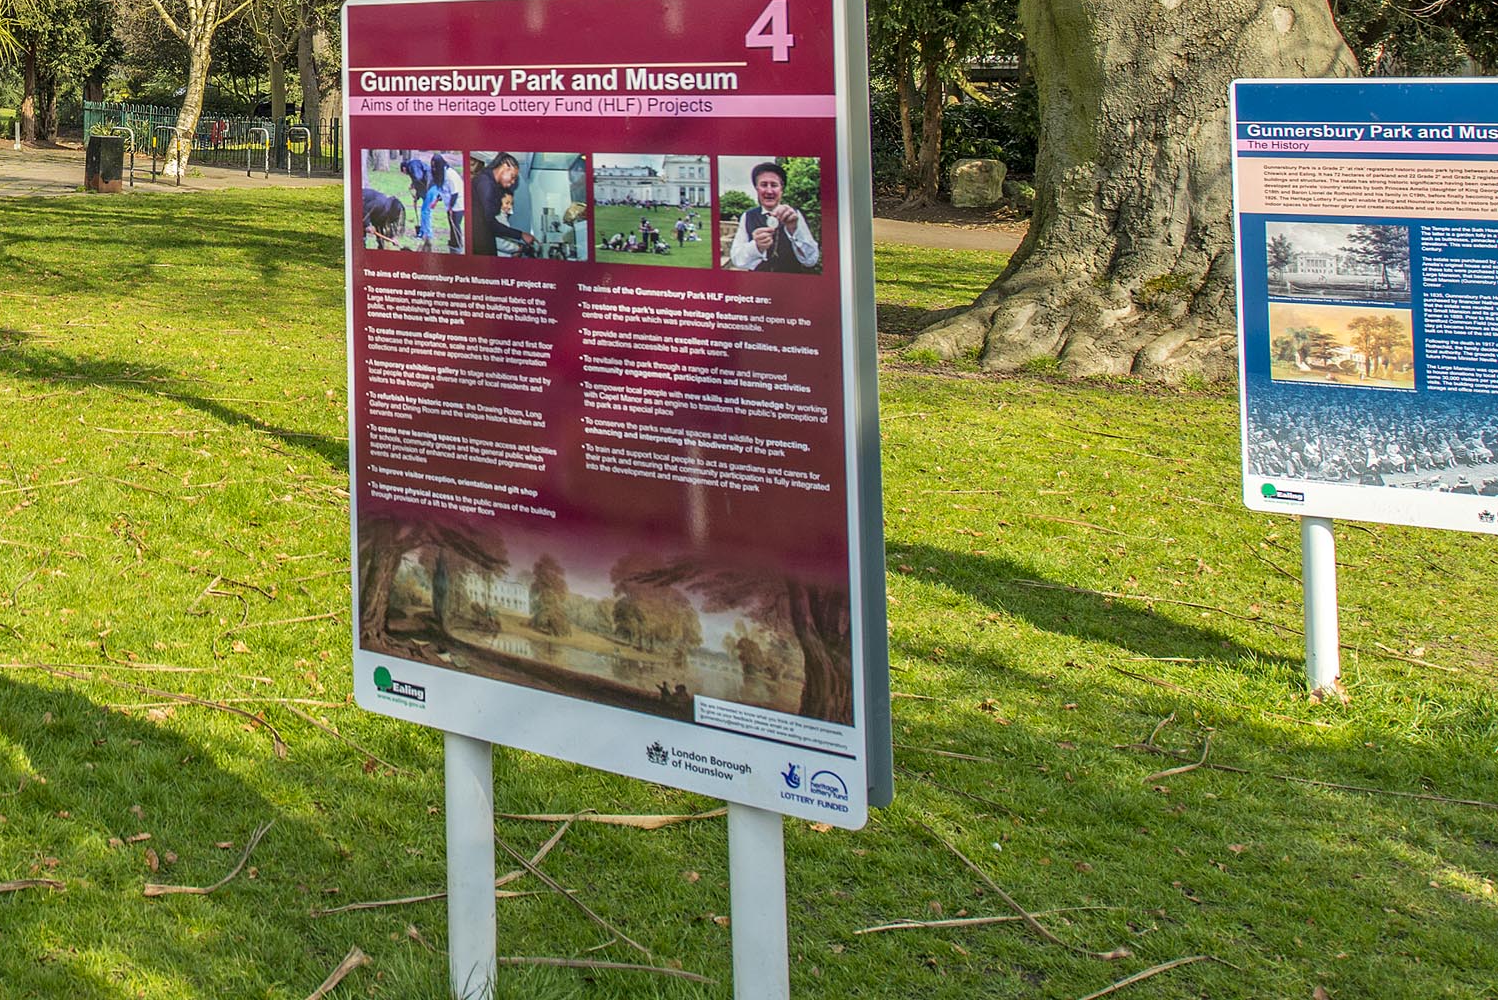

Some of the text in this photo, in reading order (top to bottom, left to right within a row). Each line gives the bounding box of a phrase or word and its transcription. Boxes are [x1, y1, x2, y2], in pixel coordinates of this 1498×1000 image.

[361, 67, 738, 97] Gunnersbury Park and Museum
[361, 95, 713, 115] Aims of the Heritage Lottery Fund (HLF) Projects
[1247, 124, 1364, 141] Gunnersbury
[1370, 125, 1413, 139] Park
[1417, 126, 1453, 139] and
[1247, 141, 1309, 152] The History
[364, 268, 375, 276] The
[376, 269, 391, 277] aims
[392, 270, 399, 278] of
[400, 270, 410, 278] the
[411, 271, 453, 283] Gunnersbury
[454, 274, 470, 283] Park
[471, 275, 499, 285] Museum
[501, 277, 515, 286] HLF
[516, 279, 541, 290] project
[578, 282, 771, 305] The aims of the Gunnersbury Park HLF project are:
[582, 300, 811, 326] To restore the park's unique heritage features and open up the
[722, 376, 738, 385] and
[739, 377, 772, 391] learning
[623, 429, 638, 439] and
[683, 436, 696, 446] the
[744, 444, 753, 452] of
[753, 445, 766, 454] the
[767, 446, 784, 458] park
[393, 682, 424, 699] Ealing
[672, 747, 752, 774] London Borough
[672, 760, 734, 781] of Hounslow
[811, 782, 839, 793] heritage
[811, 788, 848, 801] lottery fund
[781, 792, 849, 812] LOTTERY FUNDED
